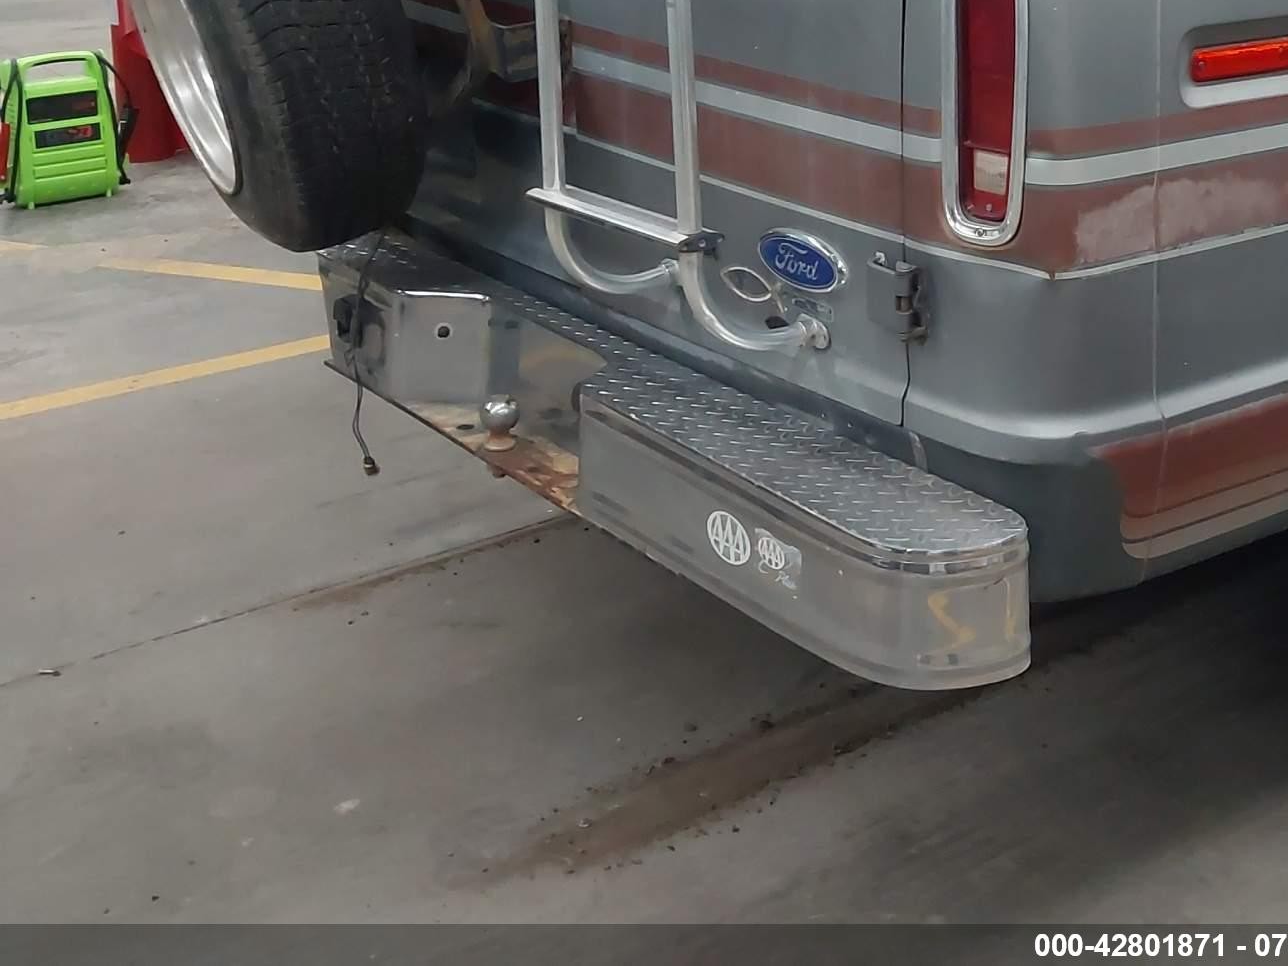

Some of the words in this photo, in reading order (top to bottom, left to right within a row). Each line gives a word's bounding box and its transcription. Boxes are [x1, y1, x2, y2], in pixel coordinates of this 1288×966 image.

[775, 242, 820, 281] Ford
[707, 510, 751, 565] AAA
[758, 537, 785, 570] AAA
